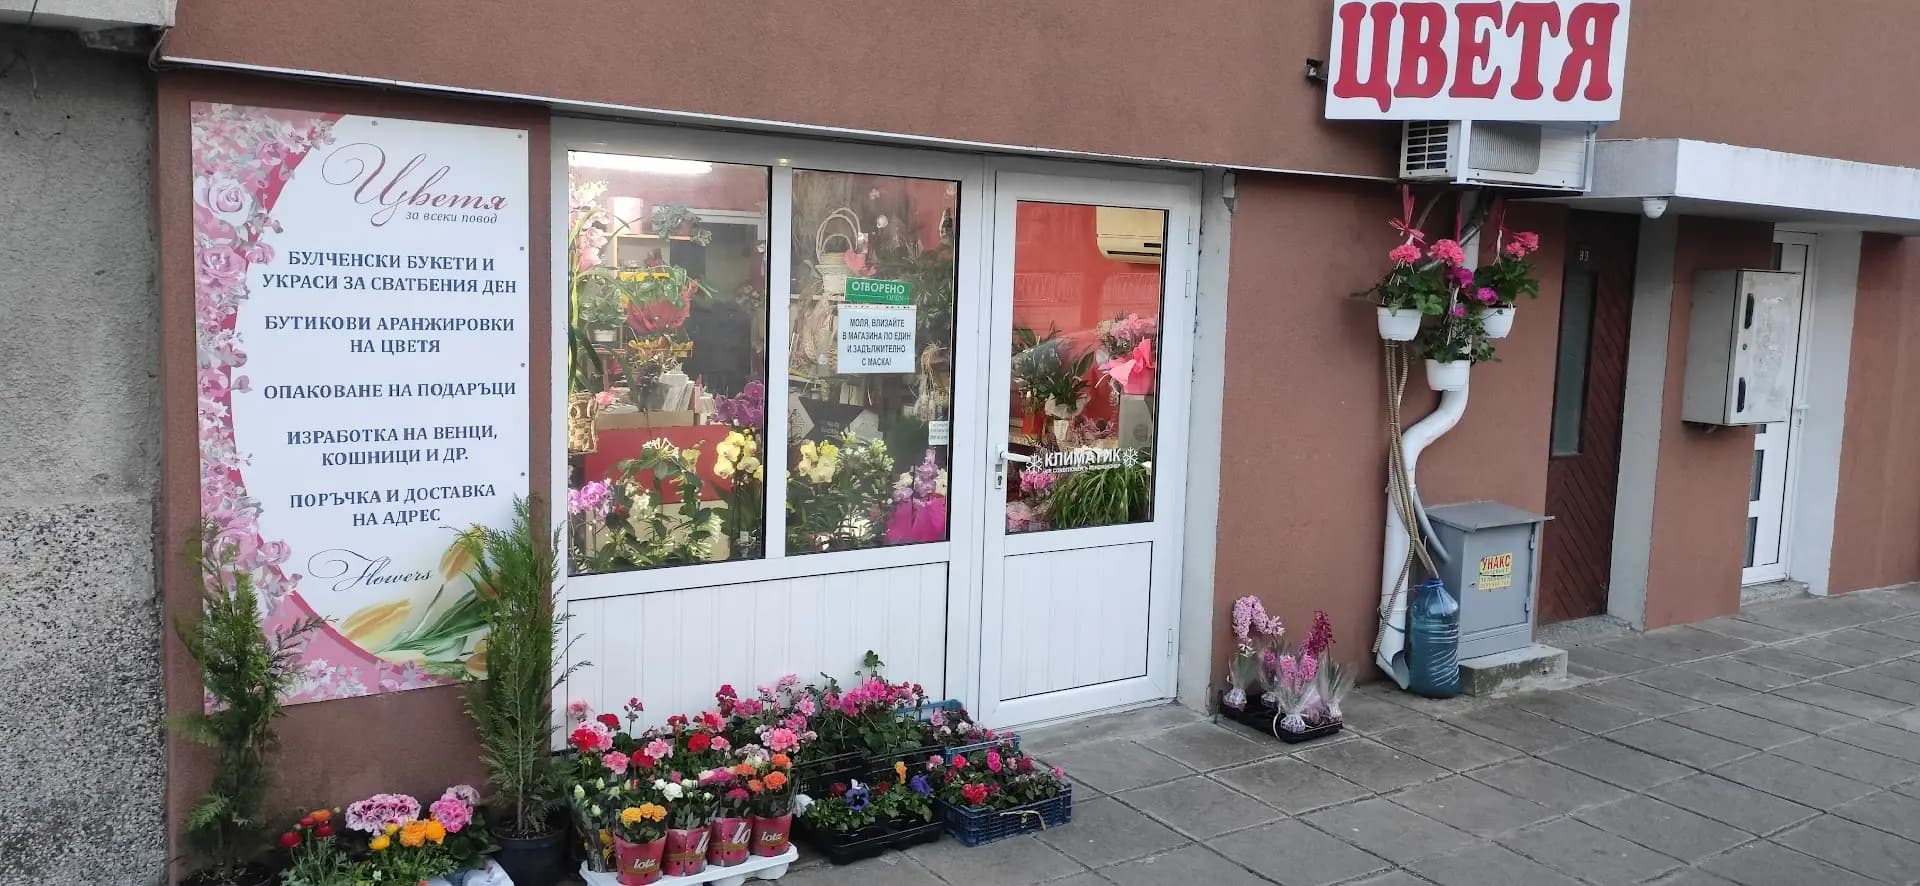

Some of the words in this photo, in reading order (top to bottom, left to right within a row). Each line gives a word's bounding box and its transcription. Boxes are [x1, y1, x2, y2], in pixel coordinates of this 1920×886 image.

[1333, 1, 1620, 113] ЦВЕТЯ
[321, 142, 508, 227] Цветя
[405, 211, 419, 220] за
[423, 211, 457, 222] всеки
[461, 214, 498, 224] повод
[289, 251, 400, 268] БУЛЧЕНСКИ
[408, 256, 477, 270] БУКЕТИ
[483, 258, 494, 271] И
[263, 274, 337, 289] УКРАСИ
[344, 276, 366, 290] ЗА
[371, 277, 478, 292] СВАТБЕНИЯ
[482, 280, 516, 296] ДЕН
[852, 282, 904, 295] ОТВОРЕНО
[265, 316, 370, 330] БУТИКОВИ
[376, 317, 514, 331] АРАНЖИРОВКИ
[850, 318, 870, 328] МОЛЯ,
[872, 317, 905, 327] ВЛИЗАЙТЕ
[842, 331, 847, 340] В
[848, 331, 882, 340] МАГАЗИНА
[883, 331, 893, 340] ПО
[894, 331, 911, 341] ЕДИН
[351, 340, 375, 352] НА
[382, 340, 440, 356] ЦВЕТЯ
[847, 344, 852, 353] И
[853, 344, 906, 353] ЗАДЪЛЖИТЕЛНО
[861, 358, 867, 366] С
[868, 358, 892, 366] МАСКА!
[264, 384, 382, 399] ОПАКОВАНЕ
[388, 384, 412, 397] НА
[418, 382, 516, 399] ПОДАРЪЦИ
[287, 429, 399, 444] ИЗРАБОТКА
[404, 428, 428, 440] НА
[434, 425, 497, 440] ВЕНЦИ,
[323, 449, 420, 466] КОШНИЦИ
[426, 449, 438, 461] И
[443, 448, 468, 464] ДР.
[1044, 448, 1121, 467] КЛИМАТИК
[290, 490, 381, 508] ПОРЪЧКА
[386, 489, 399, 502] И
[404, 484, 496, 502] ДОСТАВКА
[353, 512, 378, 526] НА
[382, 509, 440, 524] АДРЕС
[307, 549, 431, 591] Flowers
